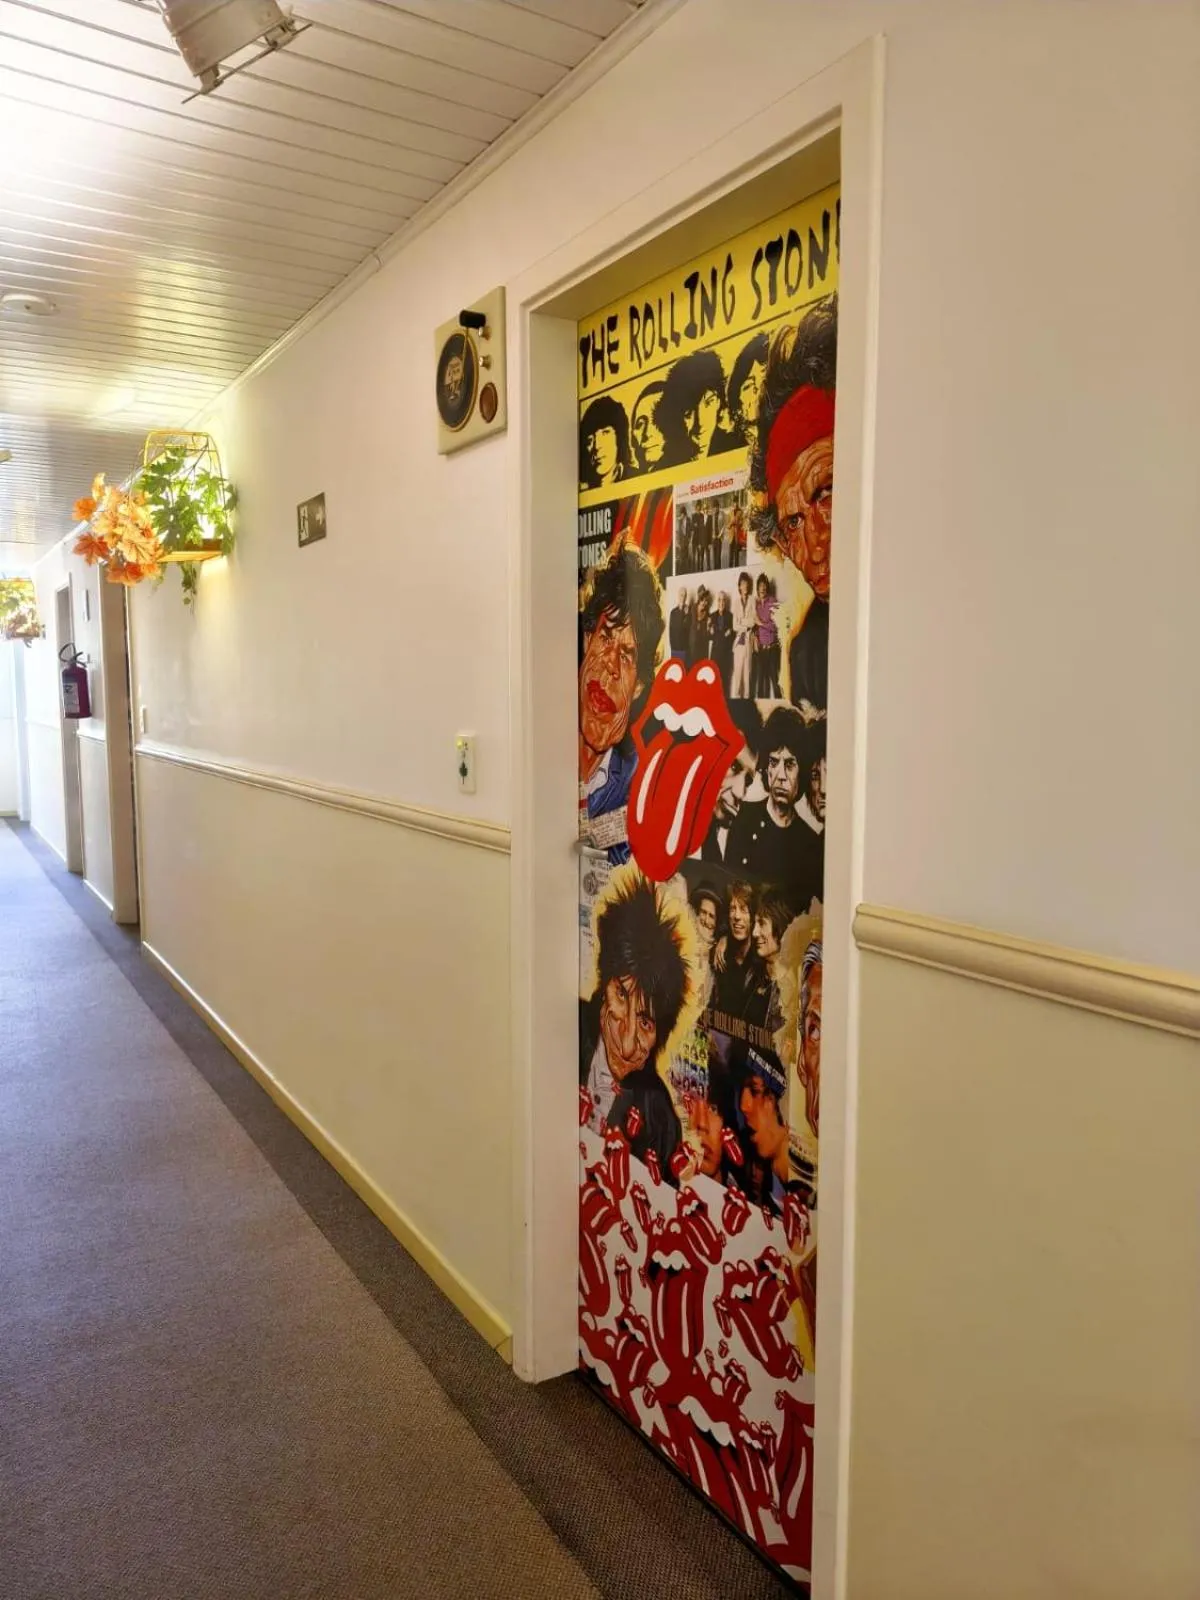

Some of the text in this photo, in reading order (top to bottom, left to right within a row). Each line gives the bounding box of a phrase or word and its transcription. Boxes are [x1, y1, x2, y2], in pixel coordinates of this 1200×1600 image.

[579, 314, 620, 389] THE
[628, 253, 735, 369] ROLLING
[690, 478, 734, 496] Satisfaction
